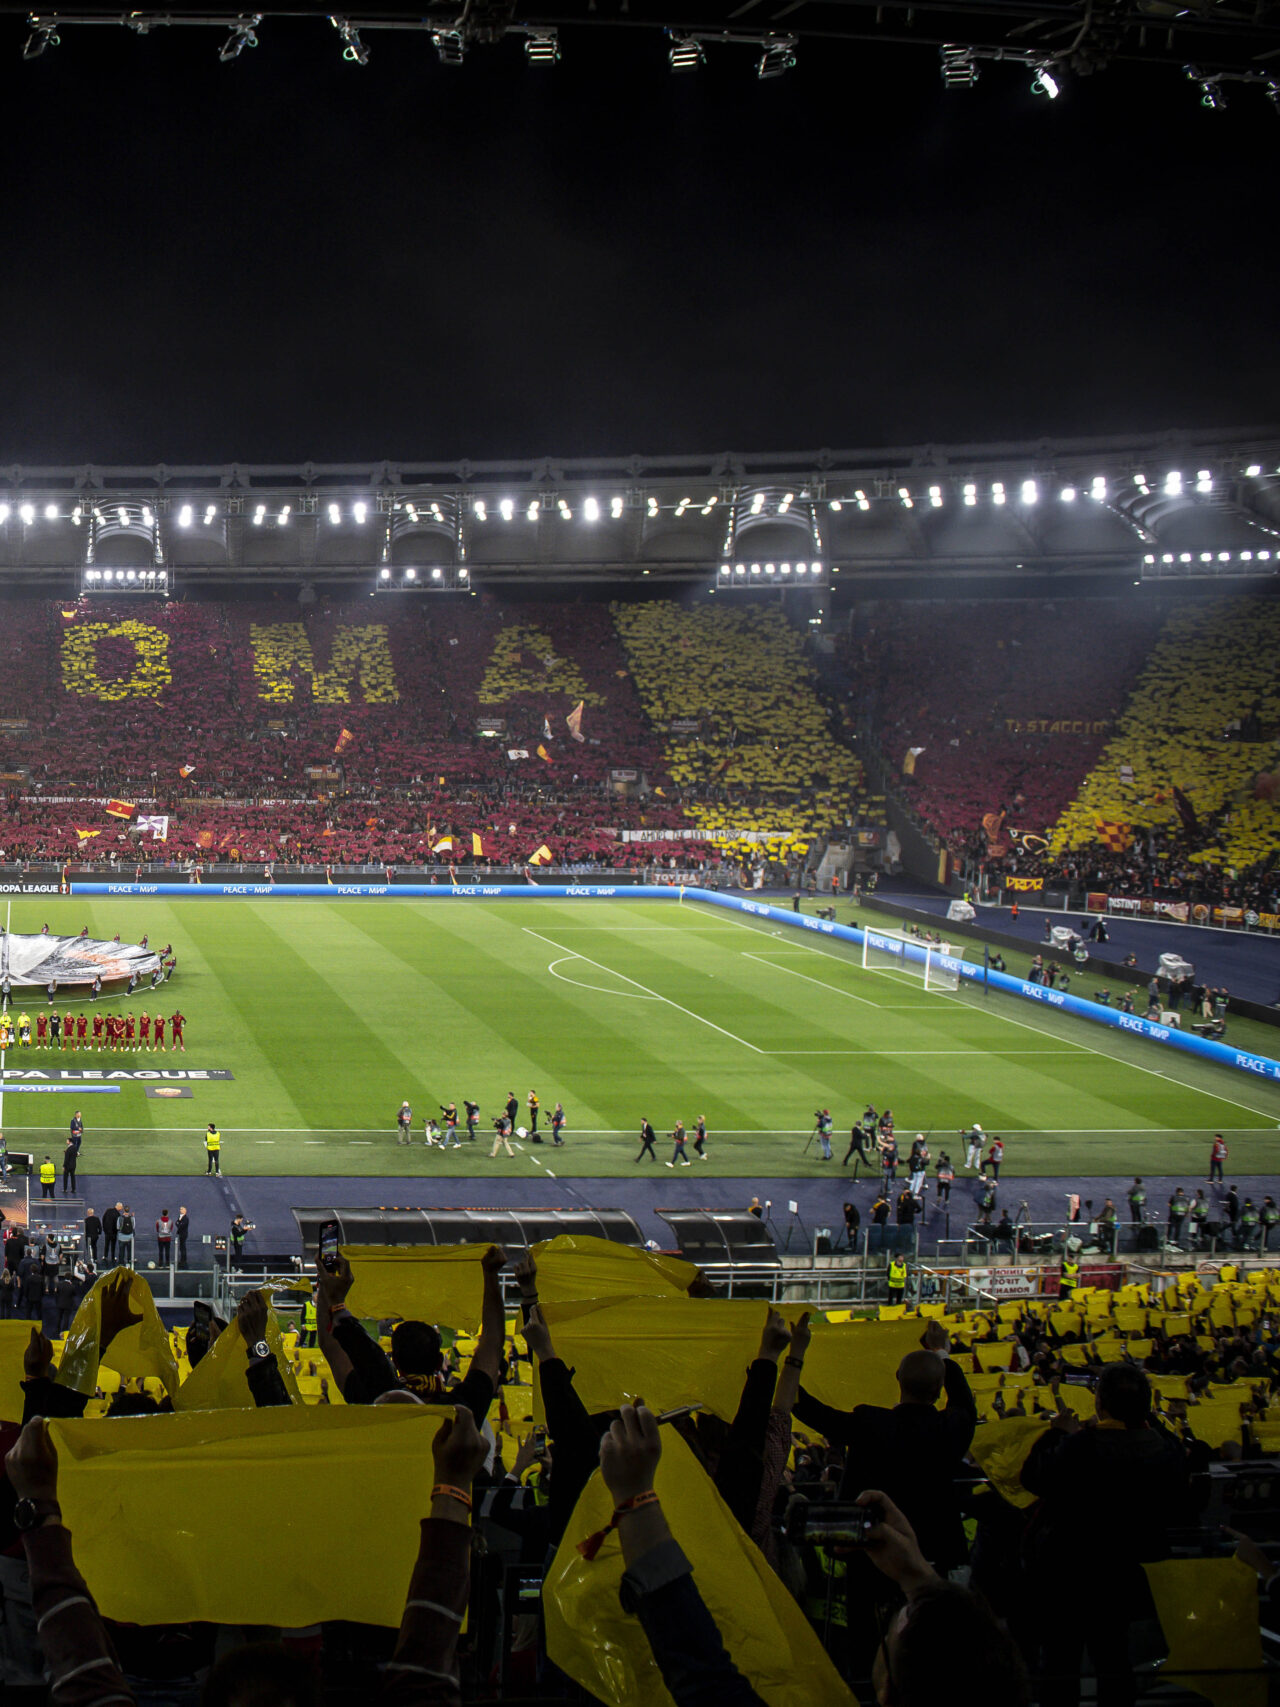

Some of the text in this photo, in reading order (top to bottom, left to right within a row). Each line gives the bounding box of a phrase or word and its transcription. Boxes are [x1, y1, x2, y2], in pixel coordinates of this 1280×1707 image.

[23, 885, 59, 893] LEAGUE
[109, 886, 132, 894] PEACE
[224, 887, 247, 895] PEACE
[338, 887, 361, 895] PEACE
[452, 888, 475, 896] PEACE
[566, 888, 589, 896] PEACE
[1022, 983, 1043, 999] PEACE
[1119, 1015, 1144, 1033] PEACE
[1236, 1054, 1267, 1074] PEACE
[60, 1070, 210, 1079] LEAGUE
